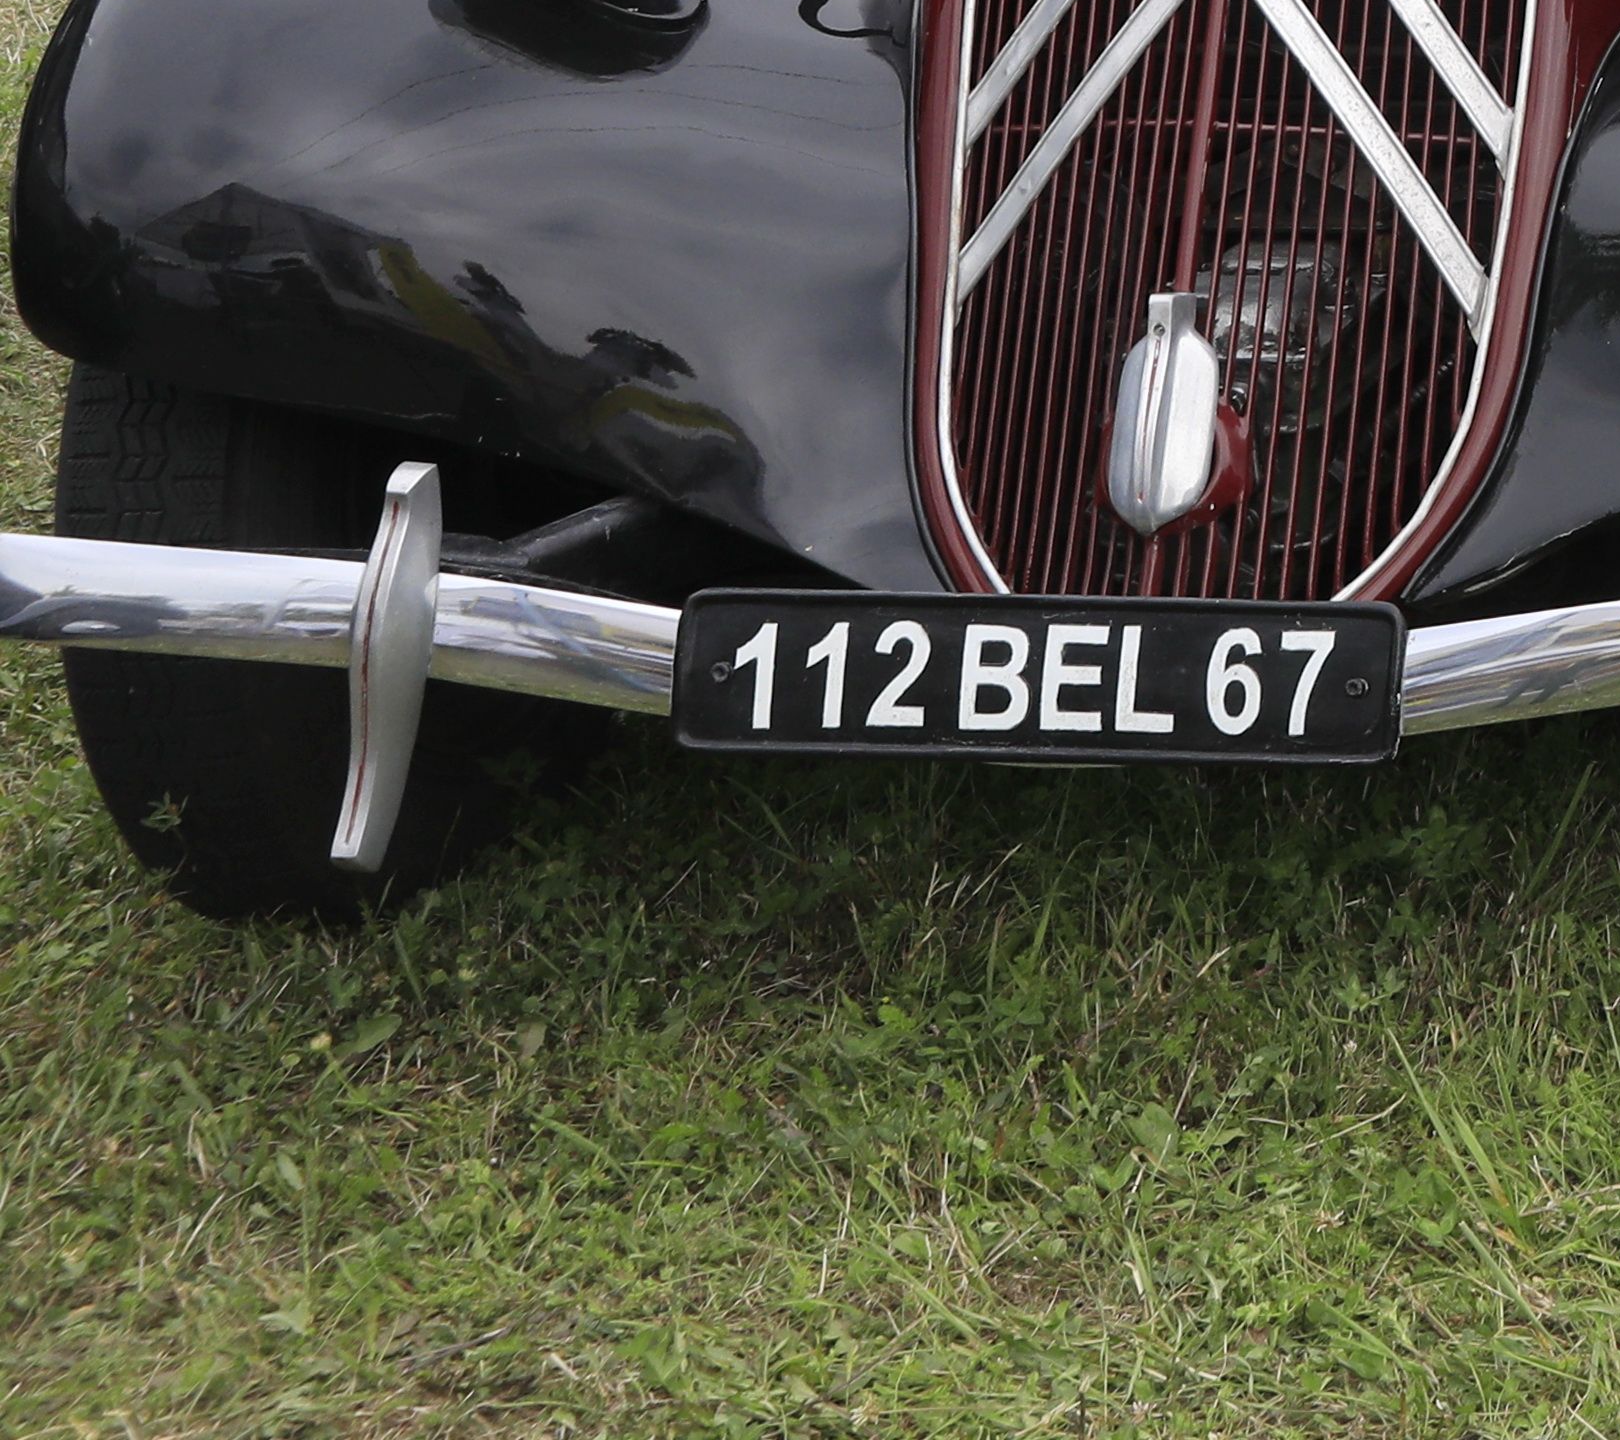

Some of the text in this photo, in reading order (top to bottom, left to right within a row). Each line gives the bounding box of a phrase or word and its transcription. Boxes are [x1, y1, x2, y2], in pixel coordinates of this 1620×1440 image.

[733, 619, 1338, 737] 112 BEL 67
